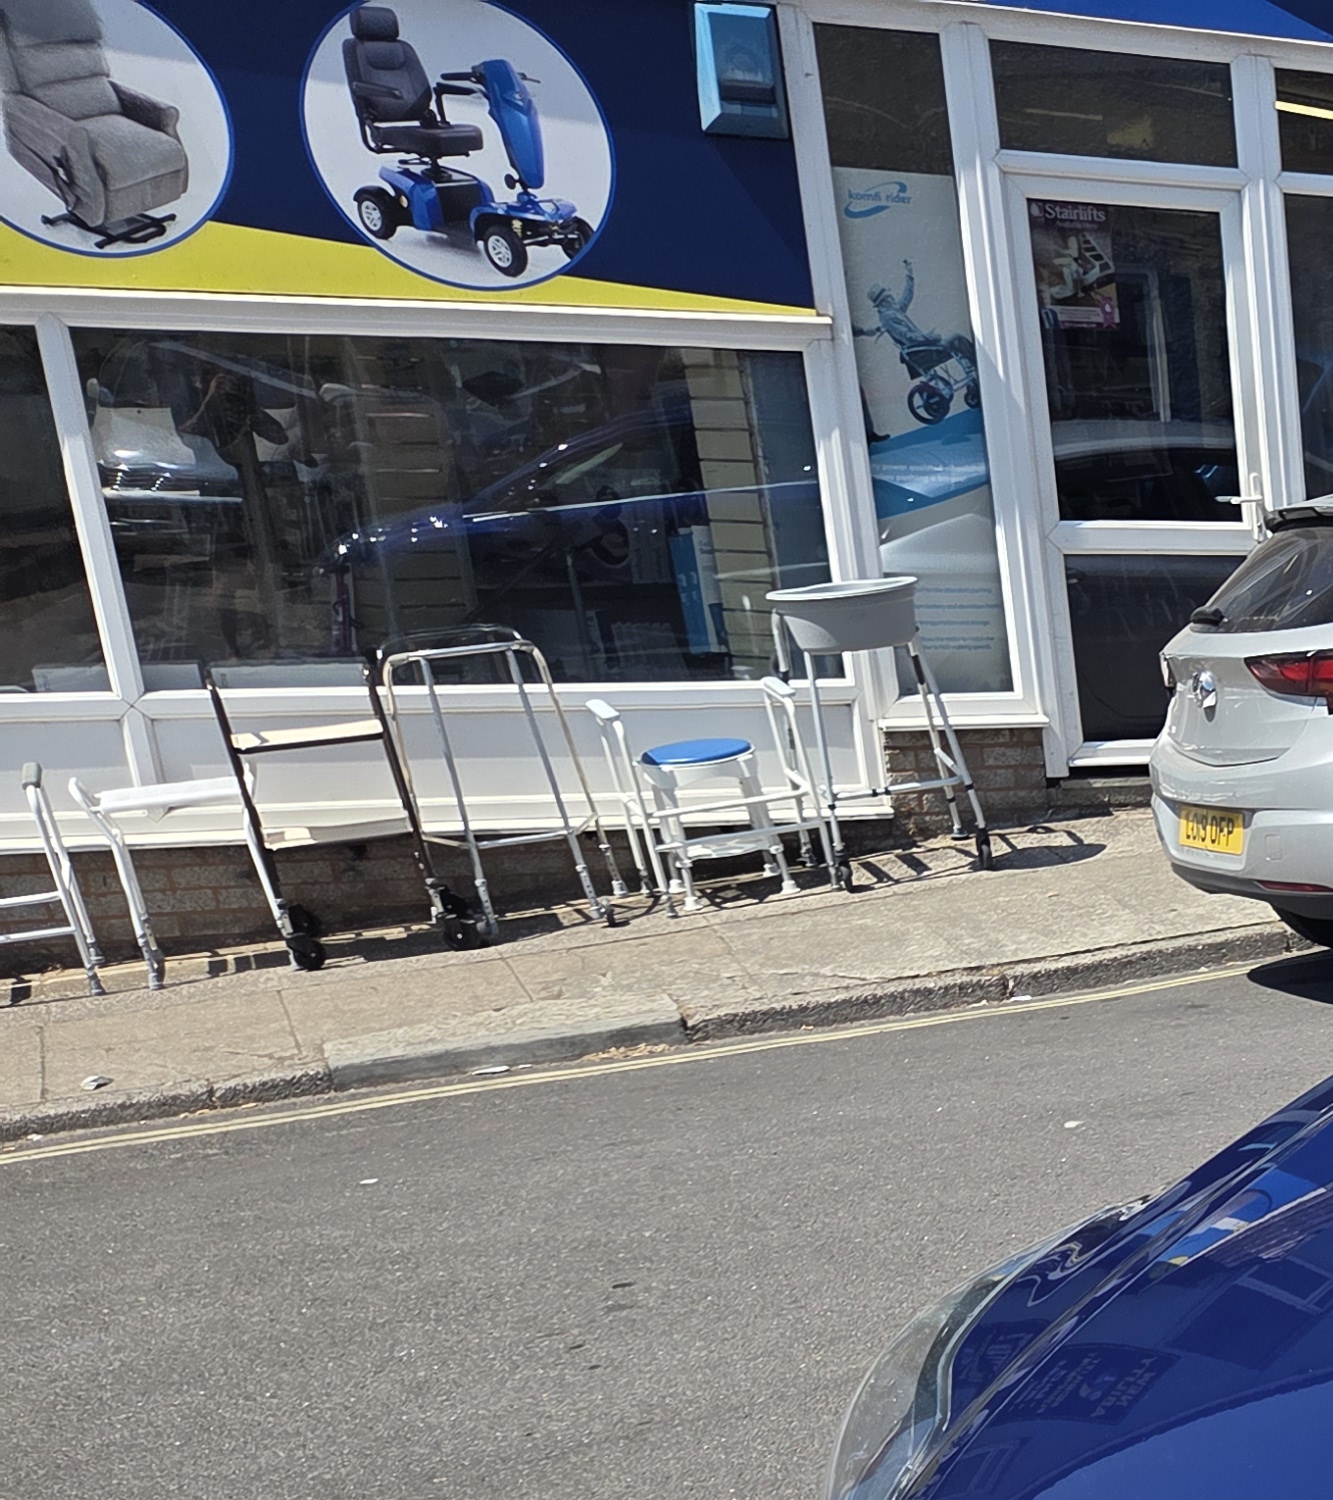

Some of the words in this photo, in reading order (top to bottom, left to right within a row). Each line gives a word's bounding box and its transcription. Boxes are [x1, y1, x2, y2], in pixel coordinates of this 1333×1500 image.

[848, 188, 882, 202] komfi
[886, 191, 912, 205] rider
[1044, 203, 1106, 223] Stairlifts
